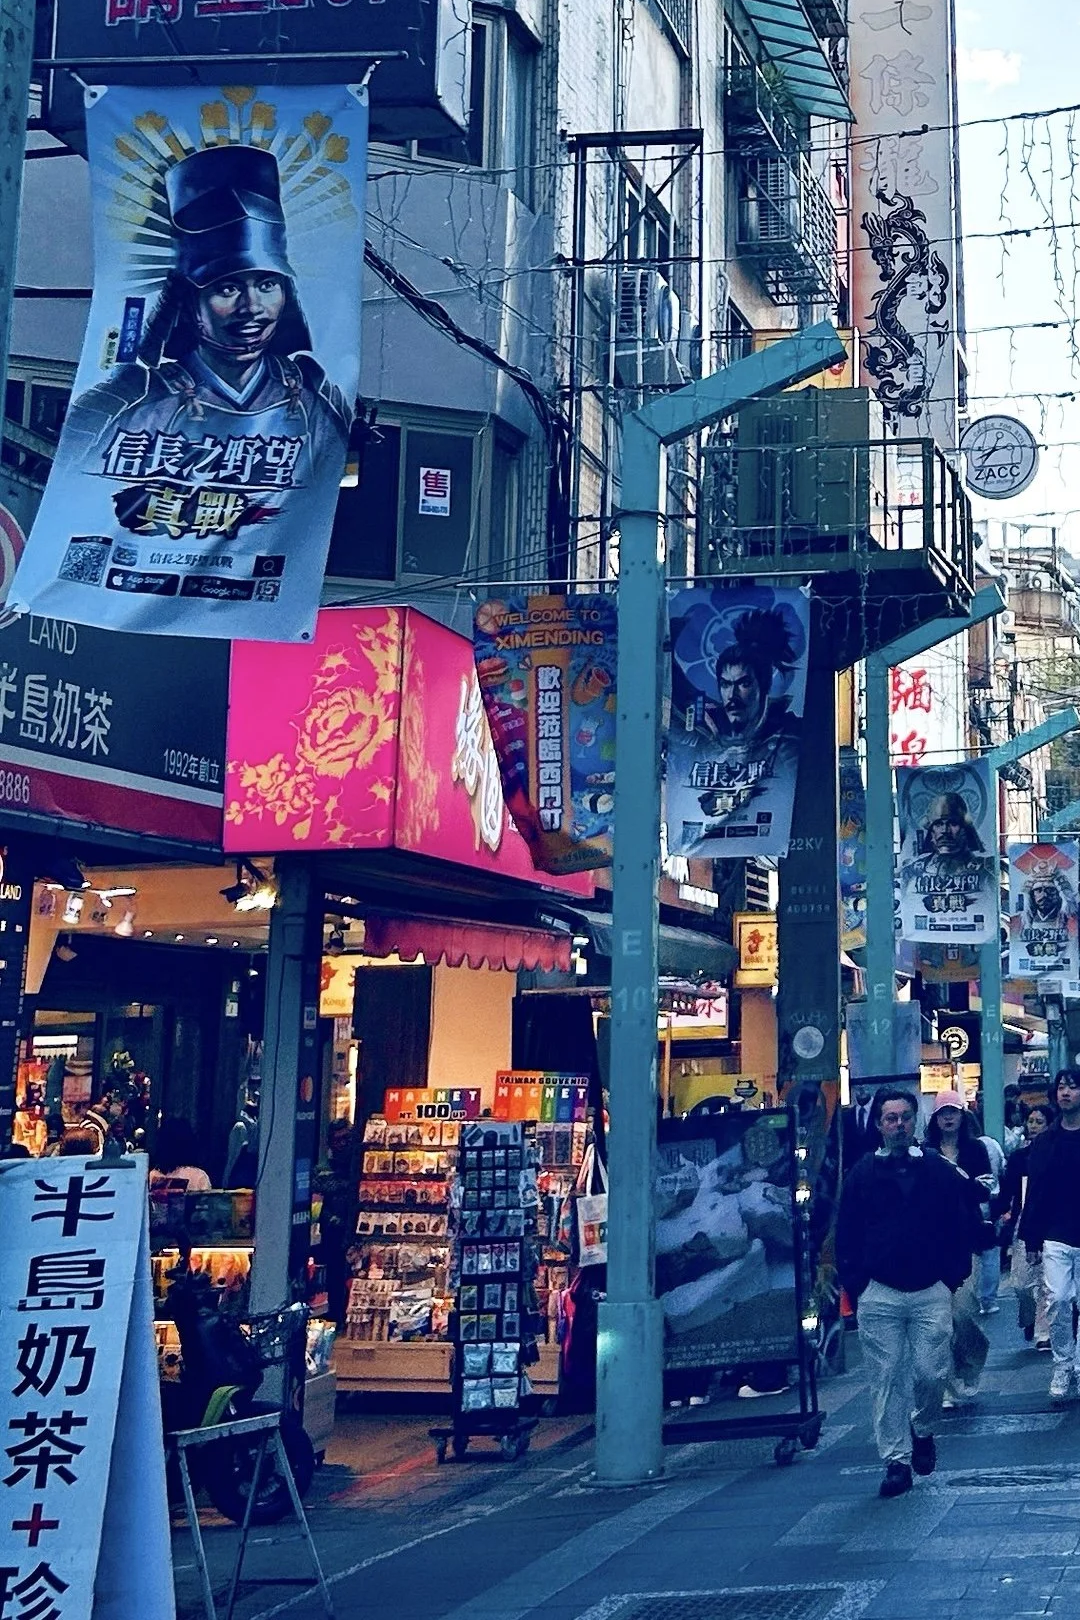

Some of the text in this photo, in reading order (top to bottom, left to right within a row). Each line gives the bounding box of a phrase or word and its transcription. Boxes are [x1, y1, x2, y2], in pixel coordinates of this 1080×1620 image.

[107, 431, 304, 486] 信長之野望
[422, 469, 449, 498] 售
[974, 465, 1020, 481] ZACC
[135, 486, 246, 537] 真戰
[496, 609, 601, 627] WELCOME TO
[29, 615, 78, 656] LAND
[496, 630, 604, 651] XIMENDING
[163, 748, 220, 784] 1992年創立
[622, 930, 642, 956] E
[615, 986, 647, 1012] 10
[499, 1076, 536, 1085] TAIWAN
[388, 1090, 478, 1103] MAGNET
[498, 1086, 587, 1099] MAGNET
[416, 1103, 450, 1119] 100
[452, 1111, 466, 1119] UP
